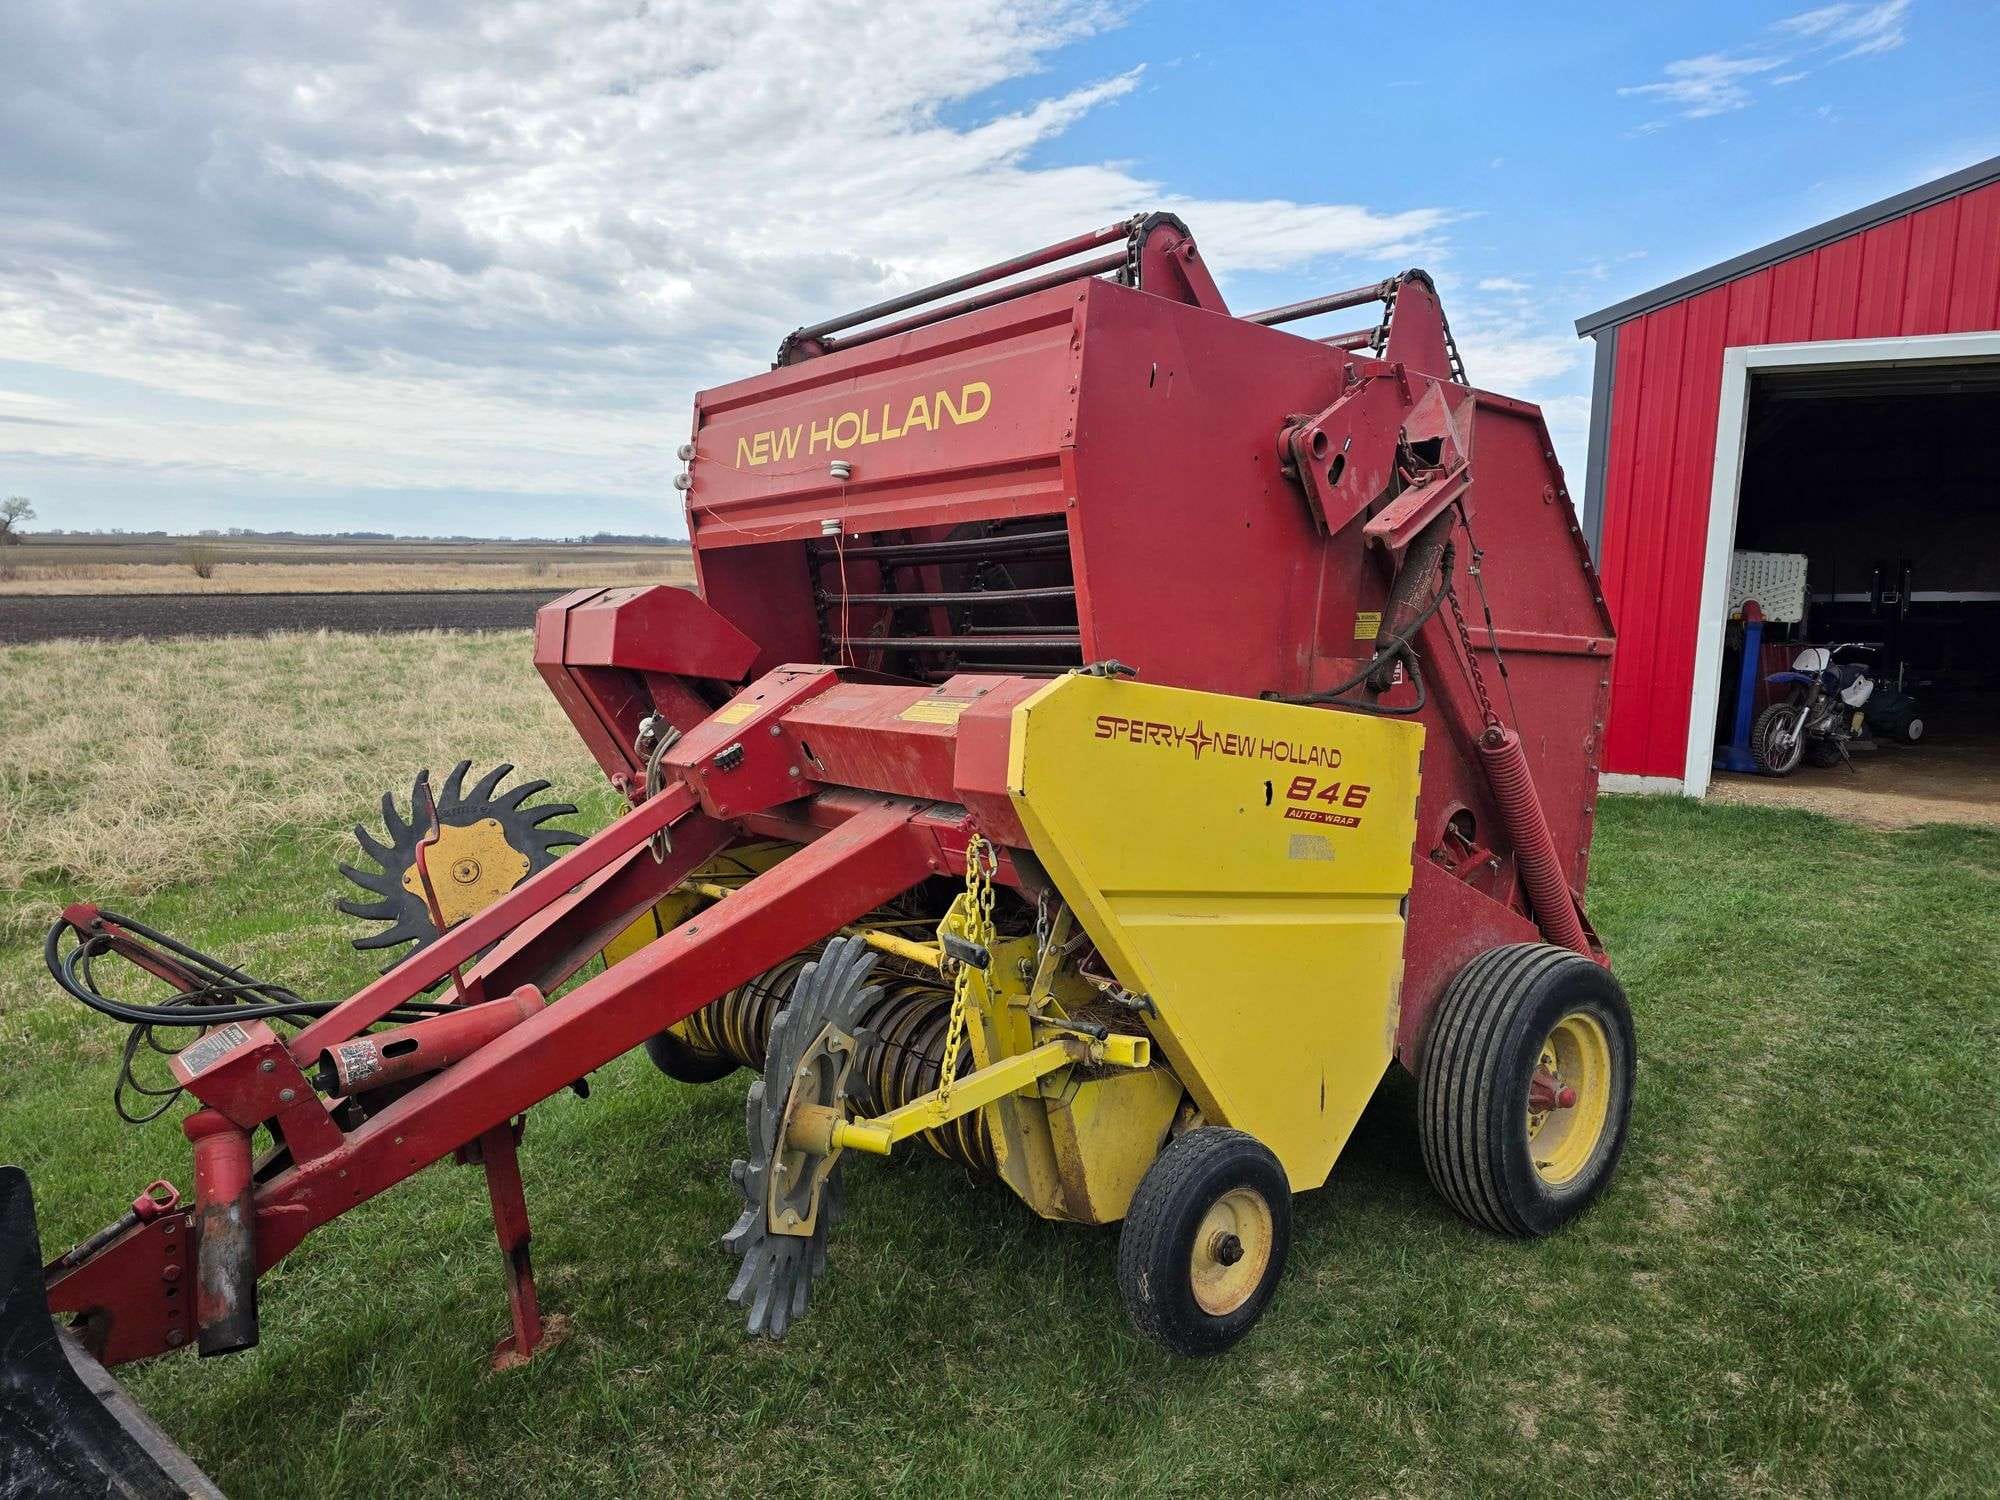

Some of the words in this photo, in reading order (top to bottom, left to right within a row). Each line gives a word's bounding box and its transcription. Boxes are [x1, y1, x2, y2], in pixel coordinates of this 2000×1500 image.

[736, 423, 803, 469] NEW
[808, 381, 992, 455] HOLLAND
[1094, 715, 1187, 748] SPERRY
[1212, 731, 1257, 757] NEW
[1260, 738, 1342, 769] HOLLAND
[1286, 775, 1371, 809] 846
